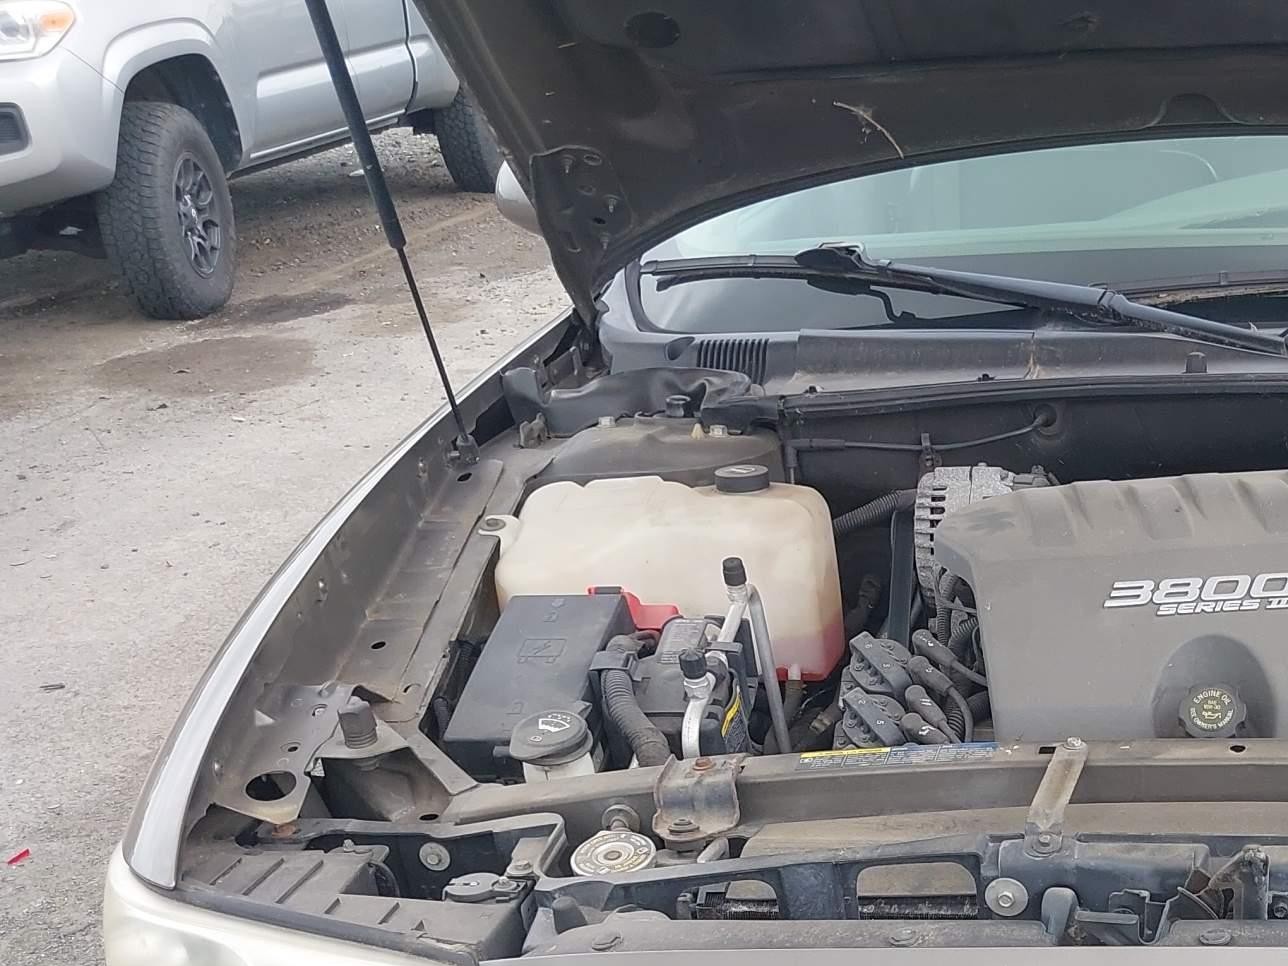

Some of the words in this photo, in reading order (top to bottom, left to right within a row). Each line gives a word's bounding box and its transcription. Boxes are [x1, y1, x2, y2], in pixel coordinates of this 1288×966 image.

[1156, 598, 1261, 616] SERIES
[1193, 690, 1221, 704] ENGINE
[1221, 695, 1232, 705] OIL
